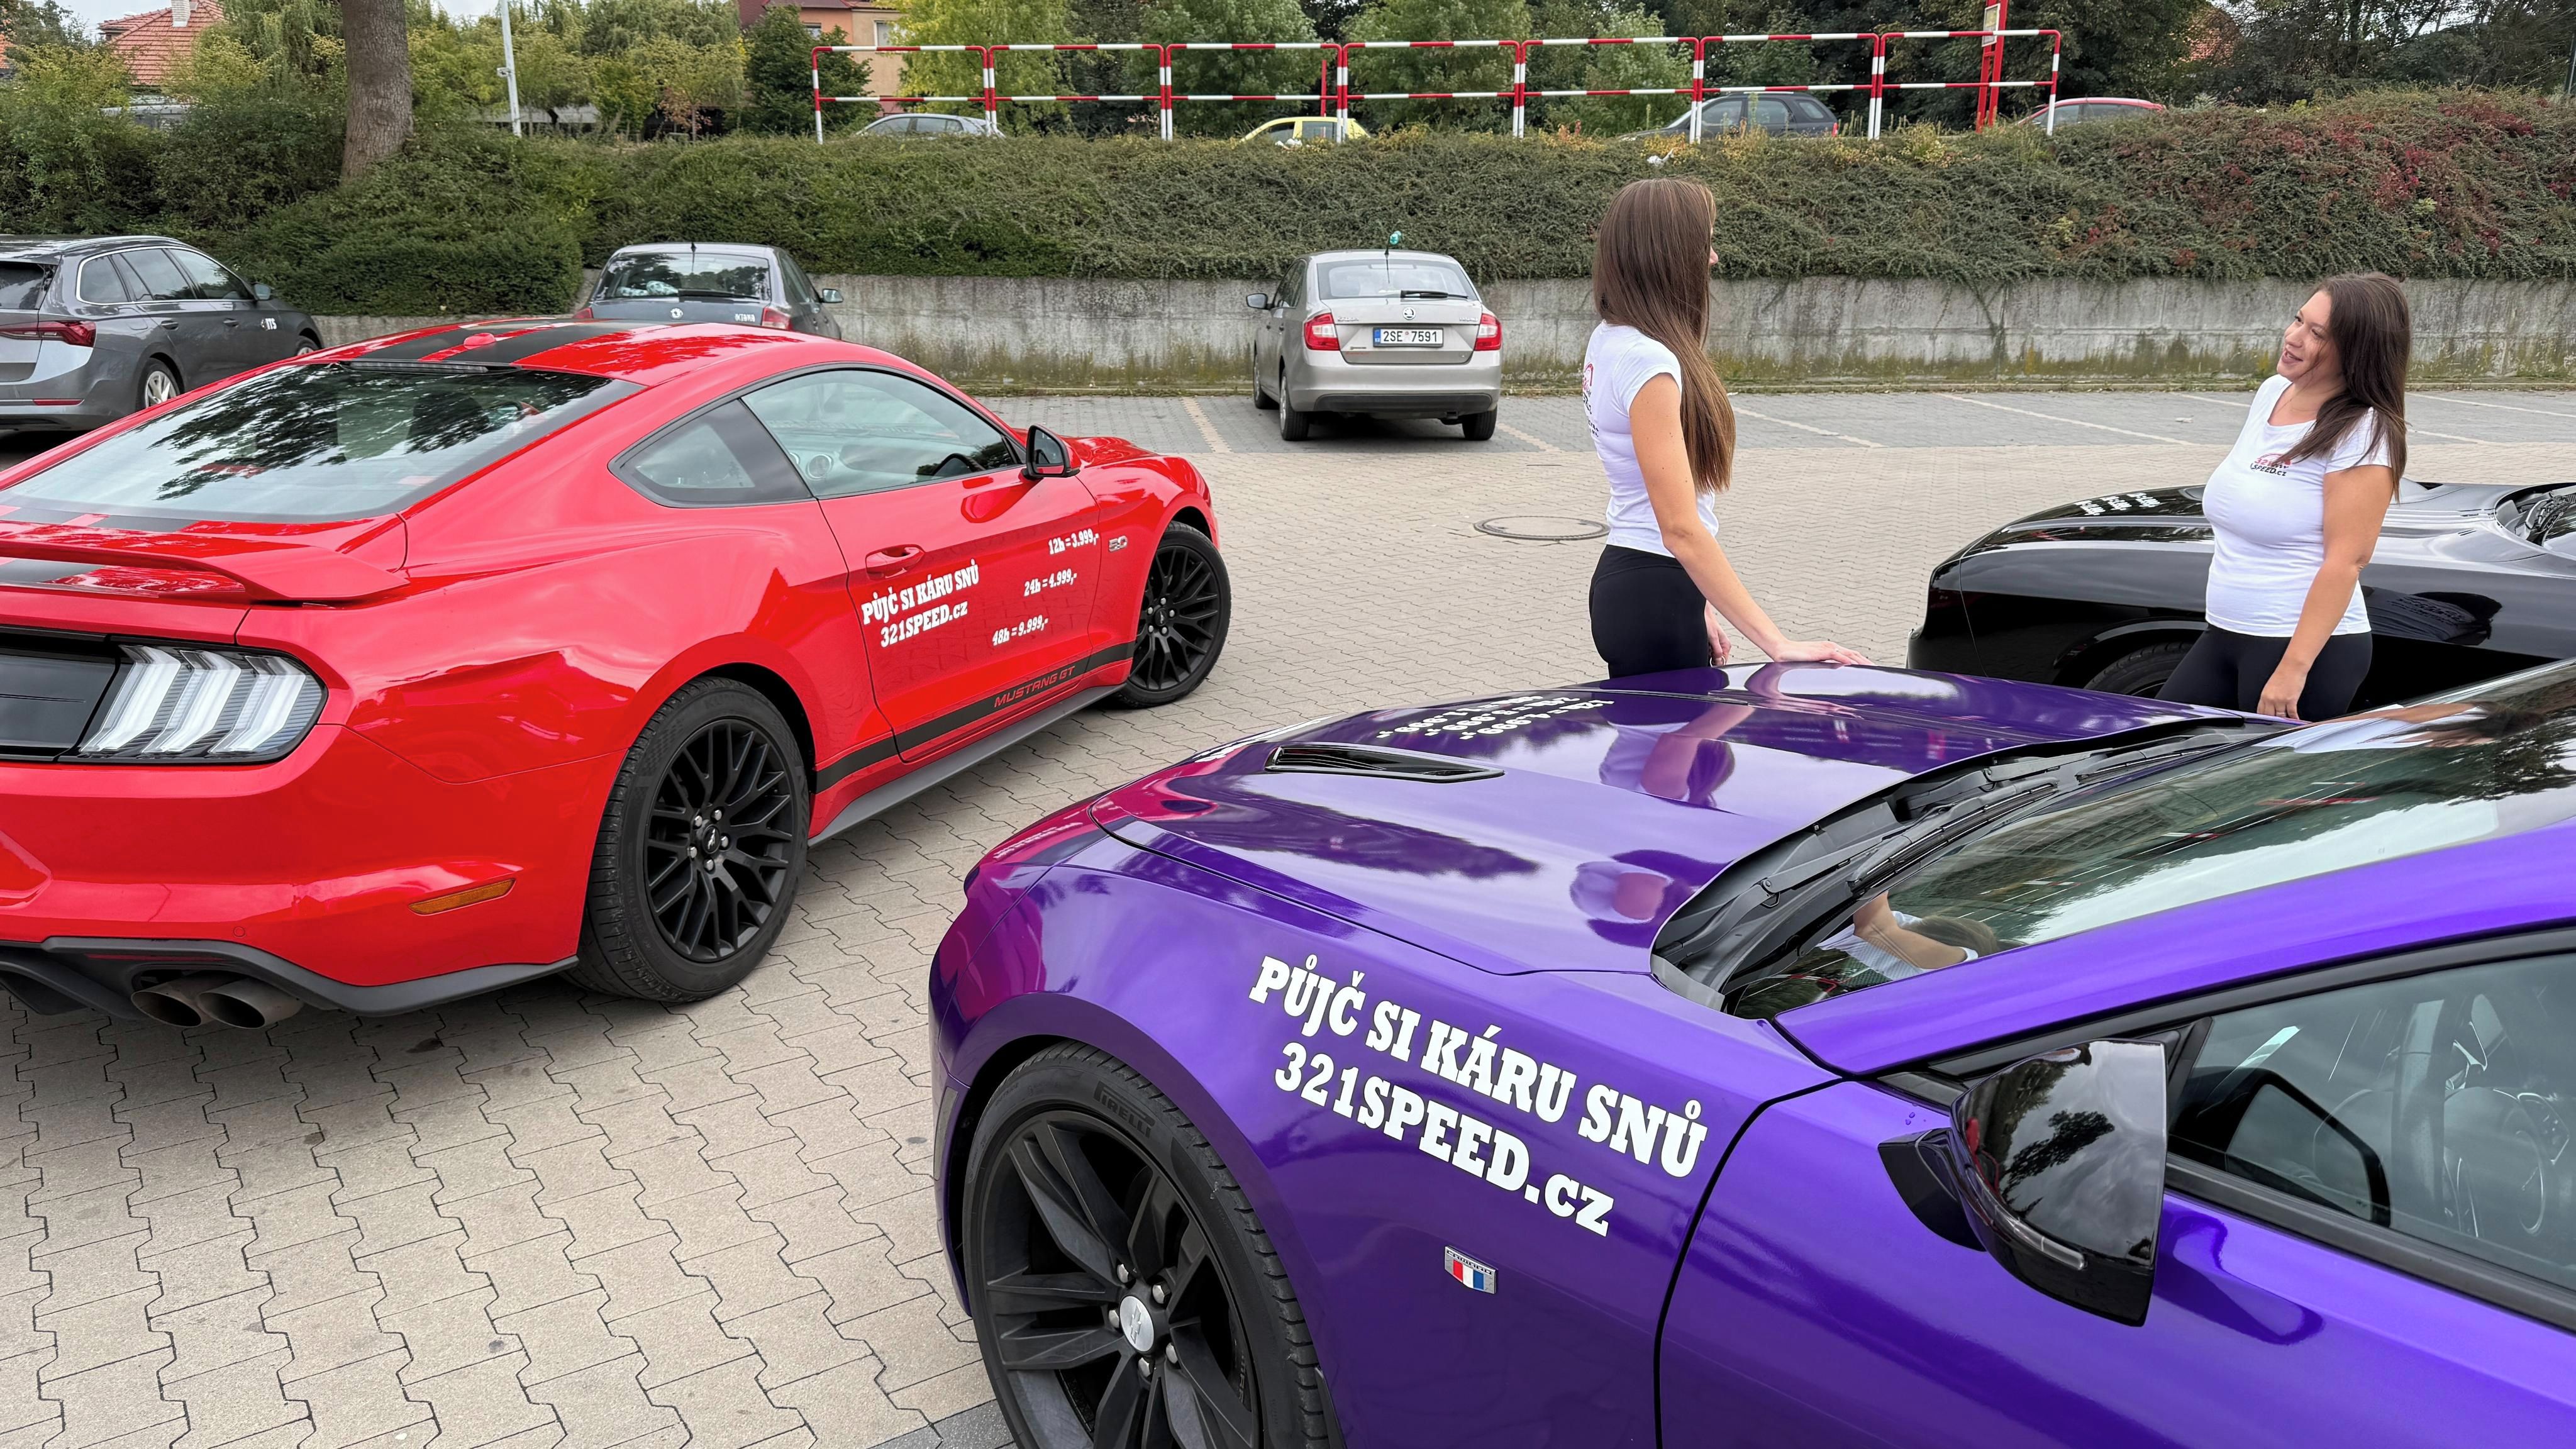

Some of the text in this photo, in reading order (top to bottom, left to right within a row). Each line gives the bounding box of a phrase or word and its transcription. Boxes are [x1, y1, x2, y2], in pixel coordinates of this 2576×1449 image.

[1383, 331, 1438, 343] 2SE 7591
[861, 558, 979, 625] PŮJČ SI KÁRU SNŮ
[994, 665, 1075, 708] MUSTANG GT
[1248, 954, 1708, 1179] PŮJČ SI KÁRU SNŮ
[1093, 1080, 1156, 1138] PIRELLI
